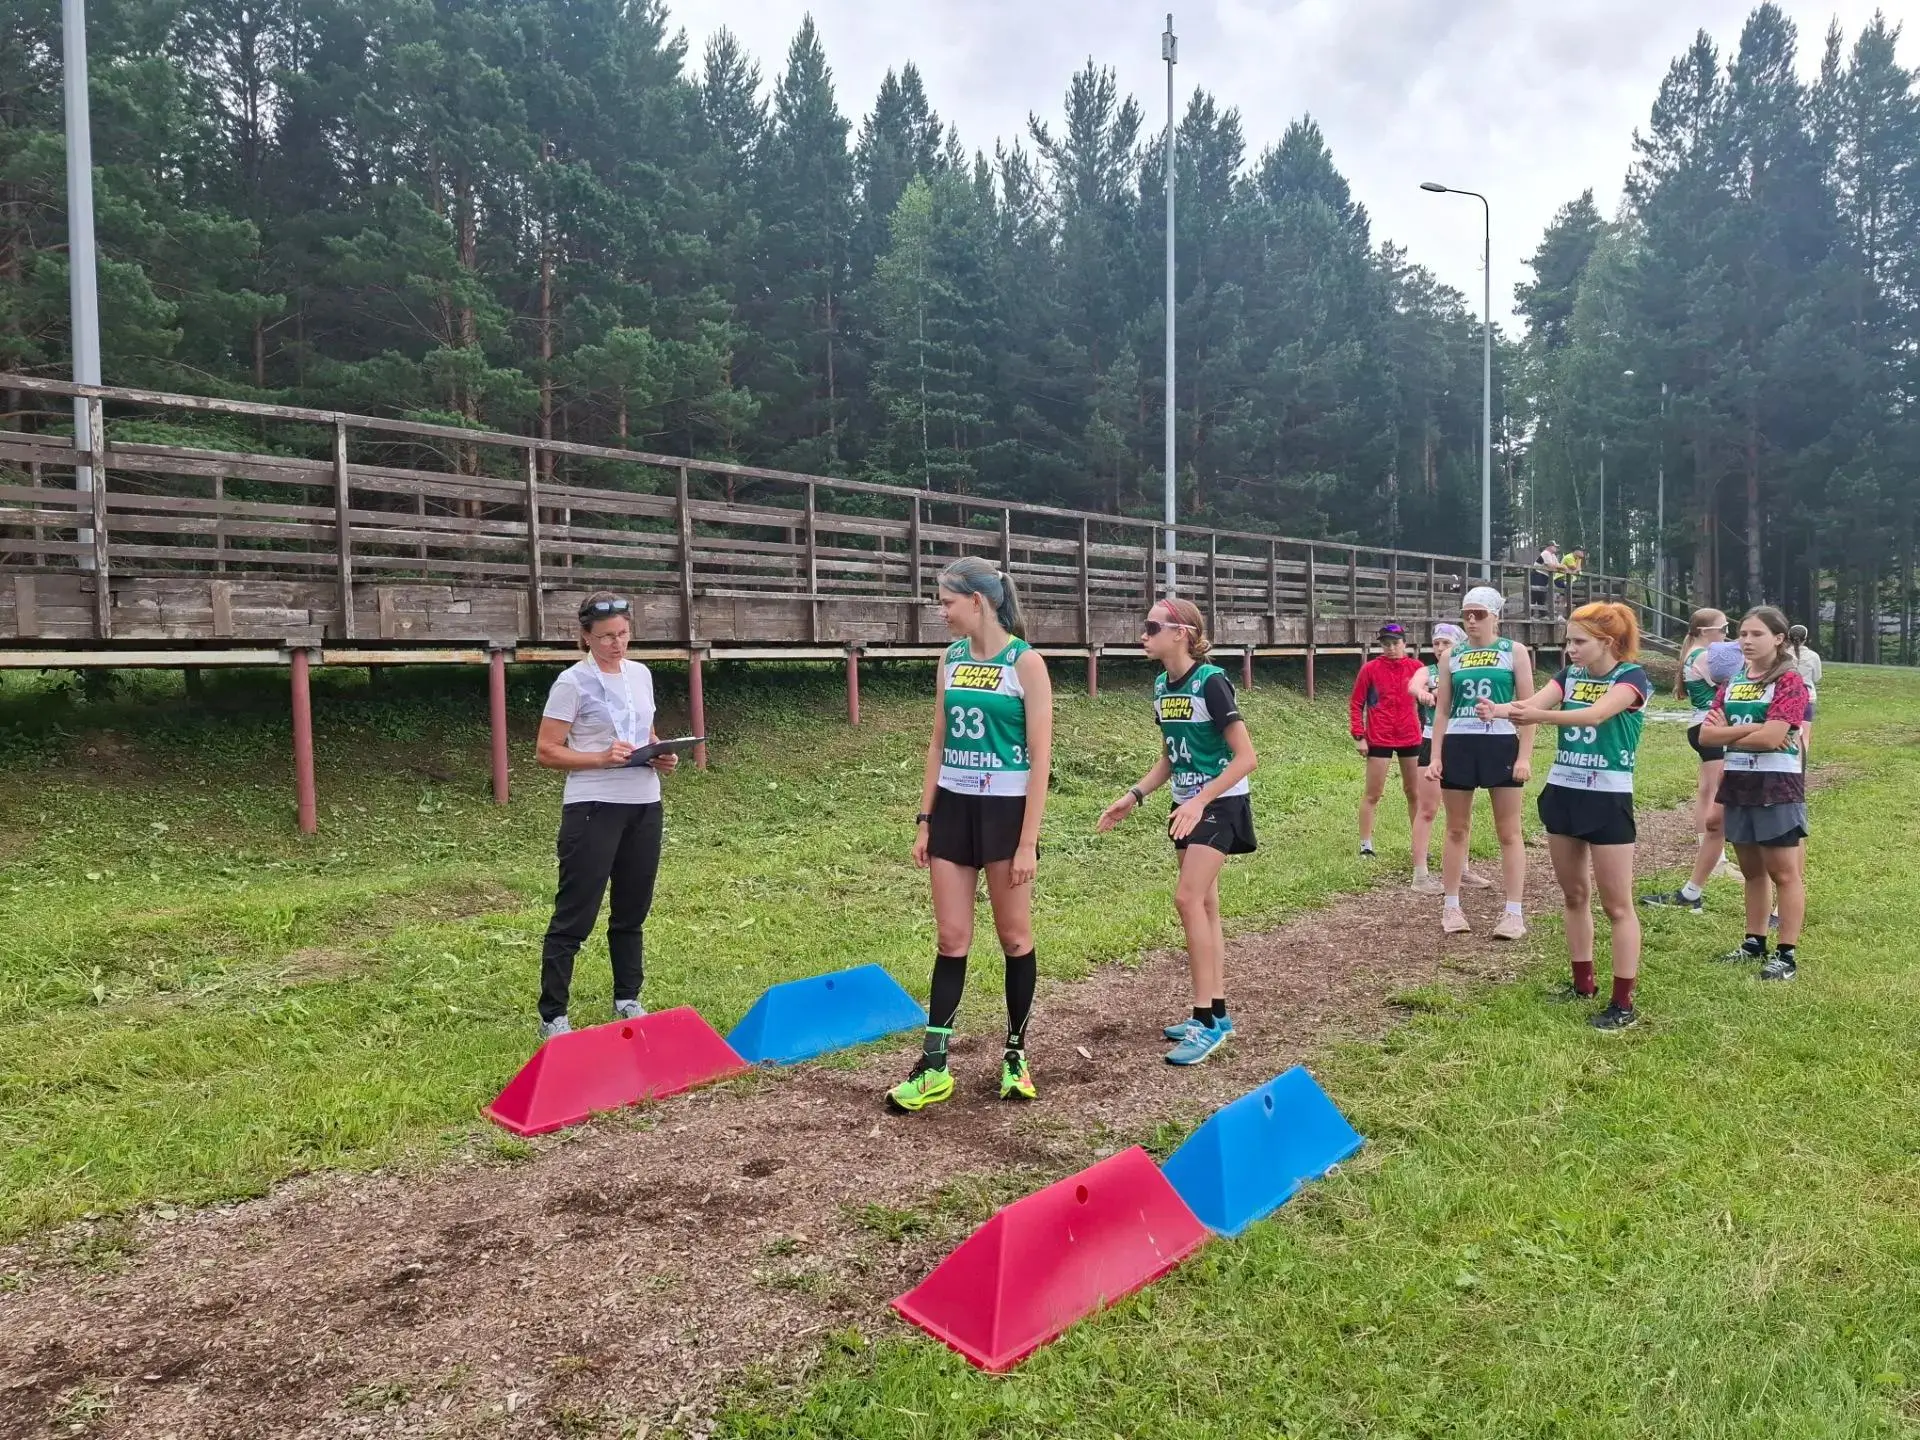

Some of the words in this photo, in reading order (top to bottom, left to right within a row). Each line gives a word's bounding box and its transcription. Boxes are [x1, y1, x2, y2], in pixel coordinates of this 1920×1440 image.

[956, 665, 1000, 678] ПАРИ
[954, 676, 999, 689] МАТЧ
[1462, 678, 1491, 699] 36
[951, 706, 985, 739] 33
[944, 748, 1002, 768] ТЮМЕНЬ
[1166, 736, 1191, 763] 34
